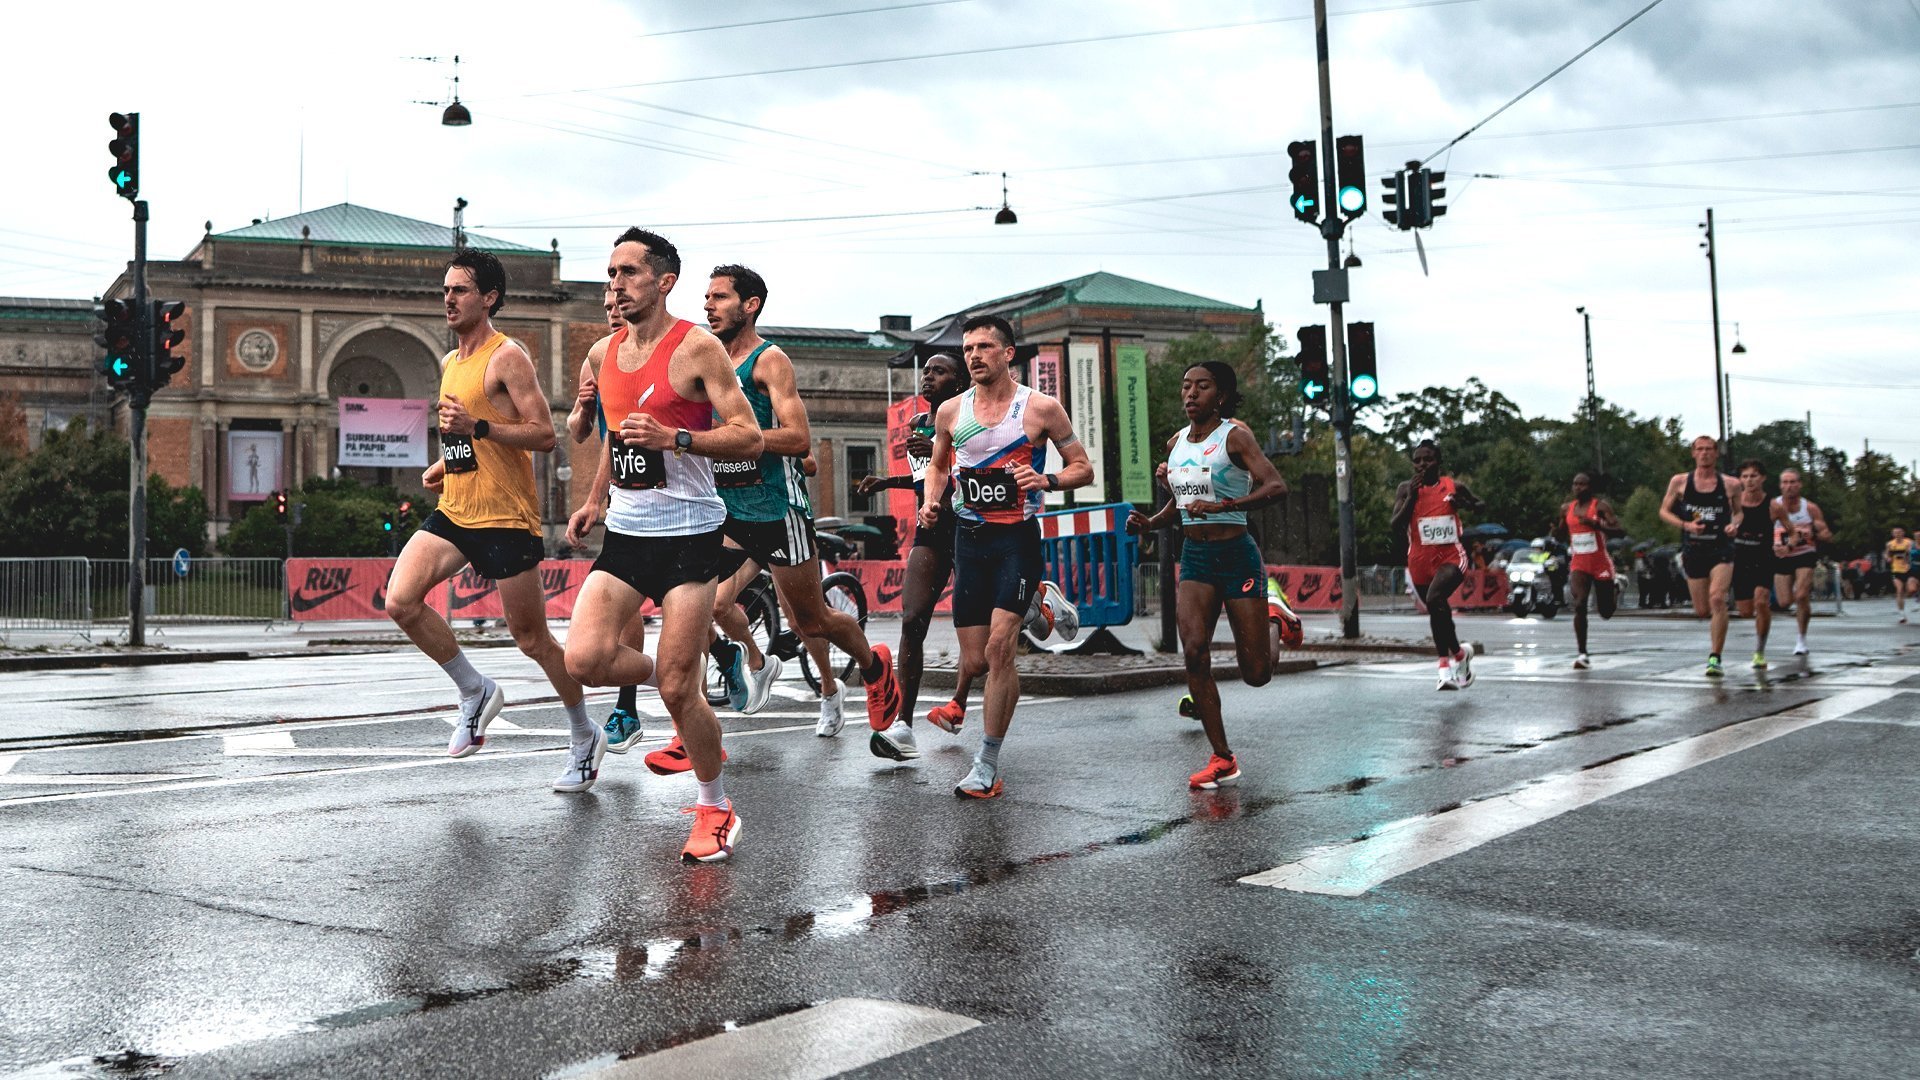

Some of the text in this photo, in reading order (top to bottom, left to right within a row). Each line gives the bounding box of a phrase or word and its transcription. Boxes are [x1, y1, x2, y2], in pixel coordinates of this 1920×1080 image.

[1047, 362, 1057, 397] SURRE
[1087, 386, 1095, 415] Museum
[1128, 375, 1139, 465] Parkmuseerne
[345, 433, 409, 443] SURREALISME
[359, 443, 386, 452] PAPIR
[442, 440, 472, 460] arvie
[612, 447, 646, 479] Fyfe
[712, 459, 757, 473] orisseau
[968, 478, 1007, 502] Dee
[1423, 525, 1454, 540] Eyayu
[304, 567, 351, 590] RUN
[541, 569, 570, 590] UN
[884, 568, 905, 587] RU
